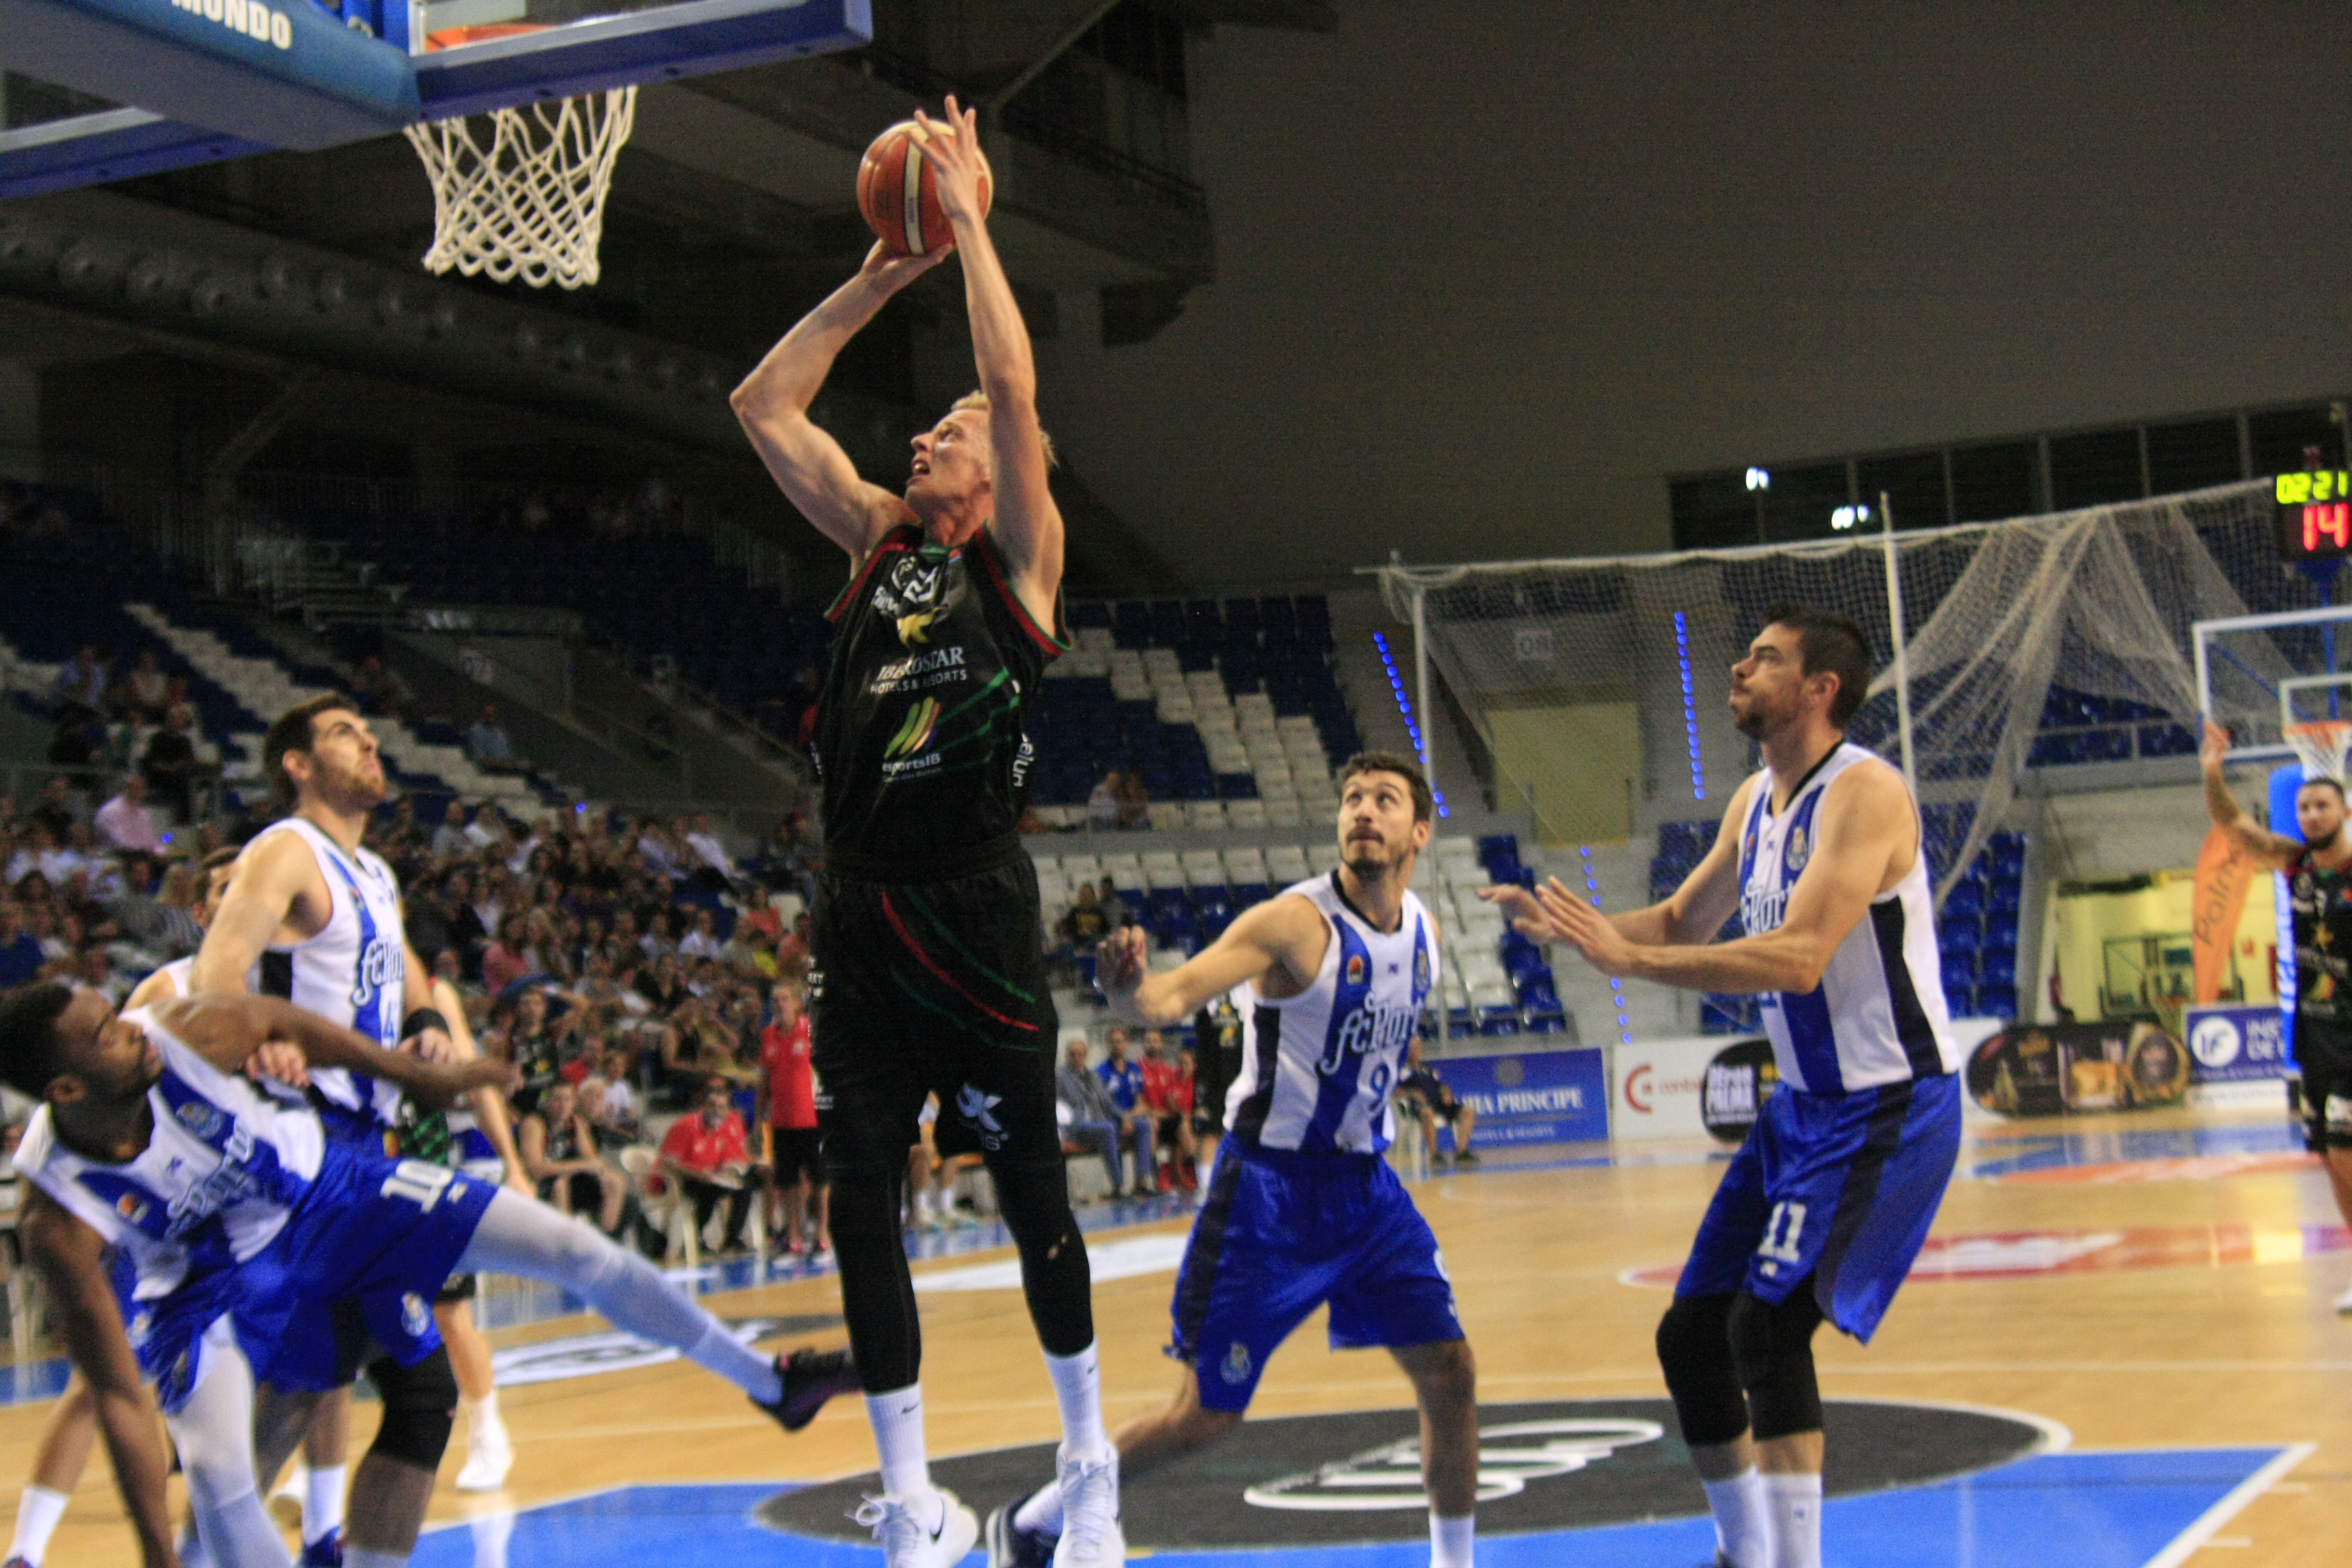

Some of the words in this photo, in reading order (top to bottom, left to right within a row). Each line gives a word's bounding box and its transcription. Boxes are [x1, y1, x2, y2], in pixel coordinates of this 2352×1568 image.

[2303, 502, 2349, 551] 14
[1497, 1087, 1584, 1114] PRINCIPE
[379, 1160, 453, 1214] 10
[1757, 1200, 1807, 1263] 11
